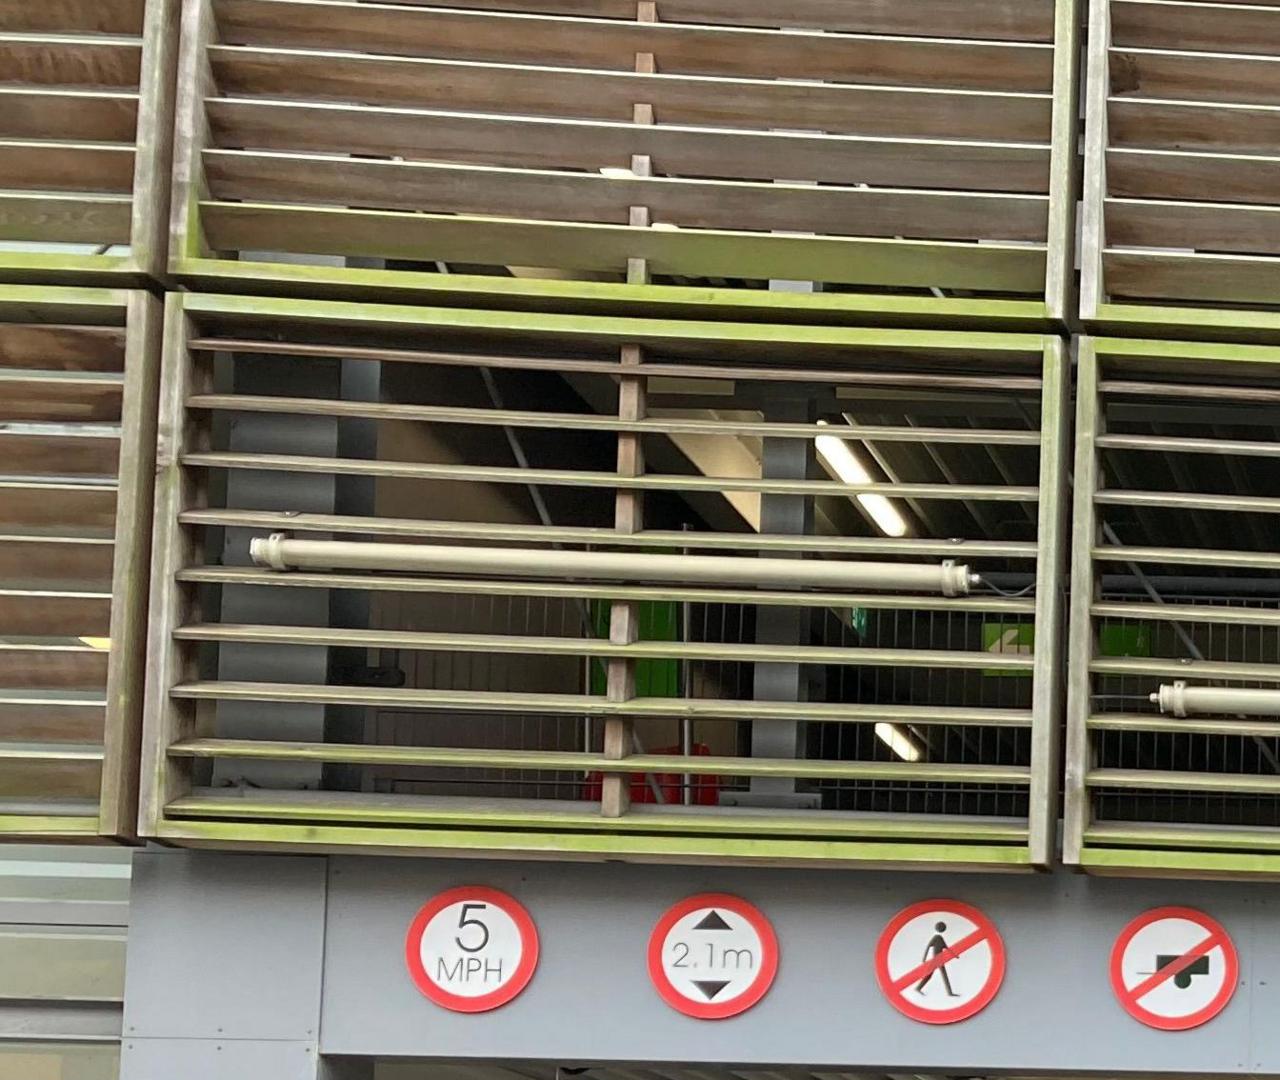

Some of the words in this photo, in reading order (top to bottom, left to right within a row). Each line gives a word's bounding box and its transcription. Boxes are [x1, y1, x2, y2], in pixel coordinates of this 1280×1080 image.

[455, 903, 490, 954] 5
[436, 956, 503, 984] MPH
[671, 941, 754, 970] 2.1m
